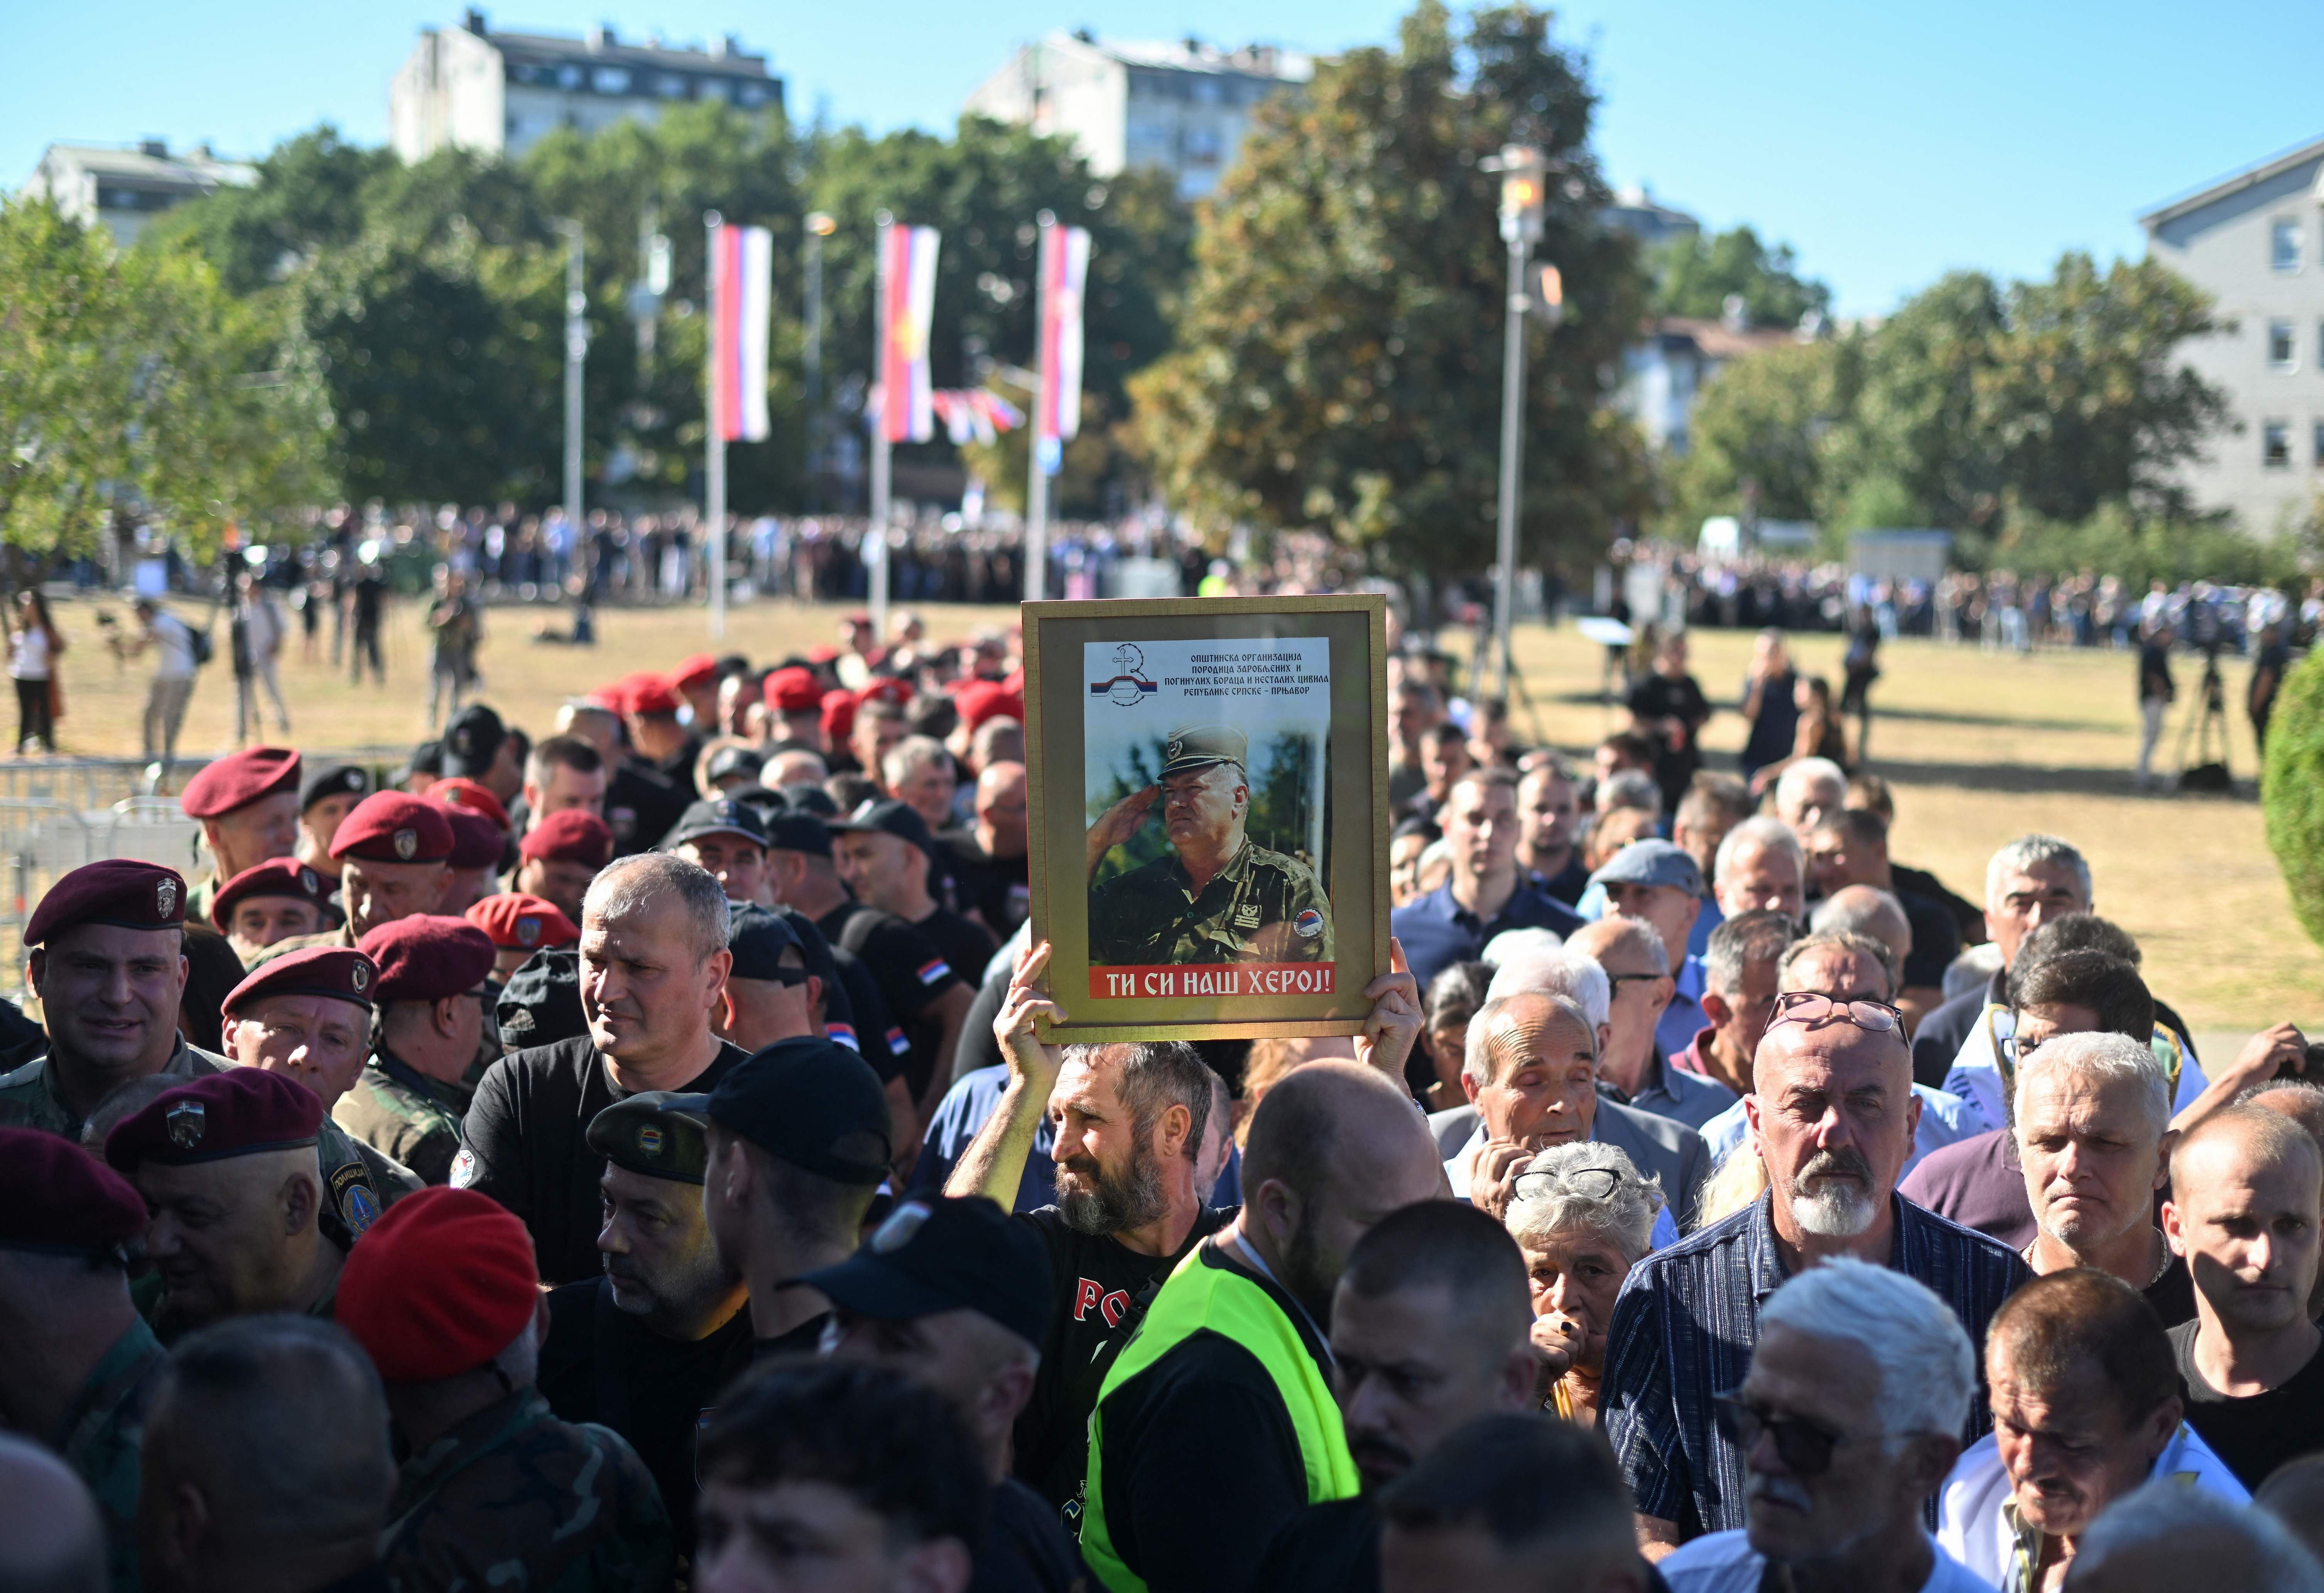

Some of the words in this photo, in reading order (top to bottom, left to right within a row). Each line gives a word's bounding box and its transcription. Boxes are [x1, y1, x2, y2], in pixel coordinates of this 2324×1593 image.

[1191, 654, 1239, 663] ОПШТИНСКА
[1241, 653, 1302, 662] ОРГАНИЗАЦИЈА
[1192, 665, 1234, 674] ПОРОДИЦА
[1237, 664, 1291, 673] ЗАРОБЉЕНИХ
[1165, 677, 1211, 685] ПОГИНУЛИХ
[1214, 676, 1245, 685] БОРАЦА
[1255, 675, 1295, 683] НЕСТАЛИХ
[1298, 675, 1329, 684] ЦИВИЛА
[1184, 688, 1229, 696] РЕПУБЛИКЕ
[1231, 687, 1262, 695] СРПСКЕ
[1271, 687, 1309, 695] ПРЊАВОР
[1106, 973, 1135, 996] ТИ
[1145, 972, 1174, 995] СИ
[1184, 971, 1238, 995] НАШ
[1248, 969, 1330, 994] ХЕРОЈ!
[335, 1169, 365, 1189] ПОЛИЦИЈА
